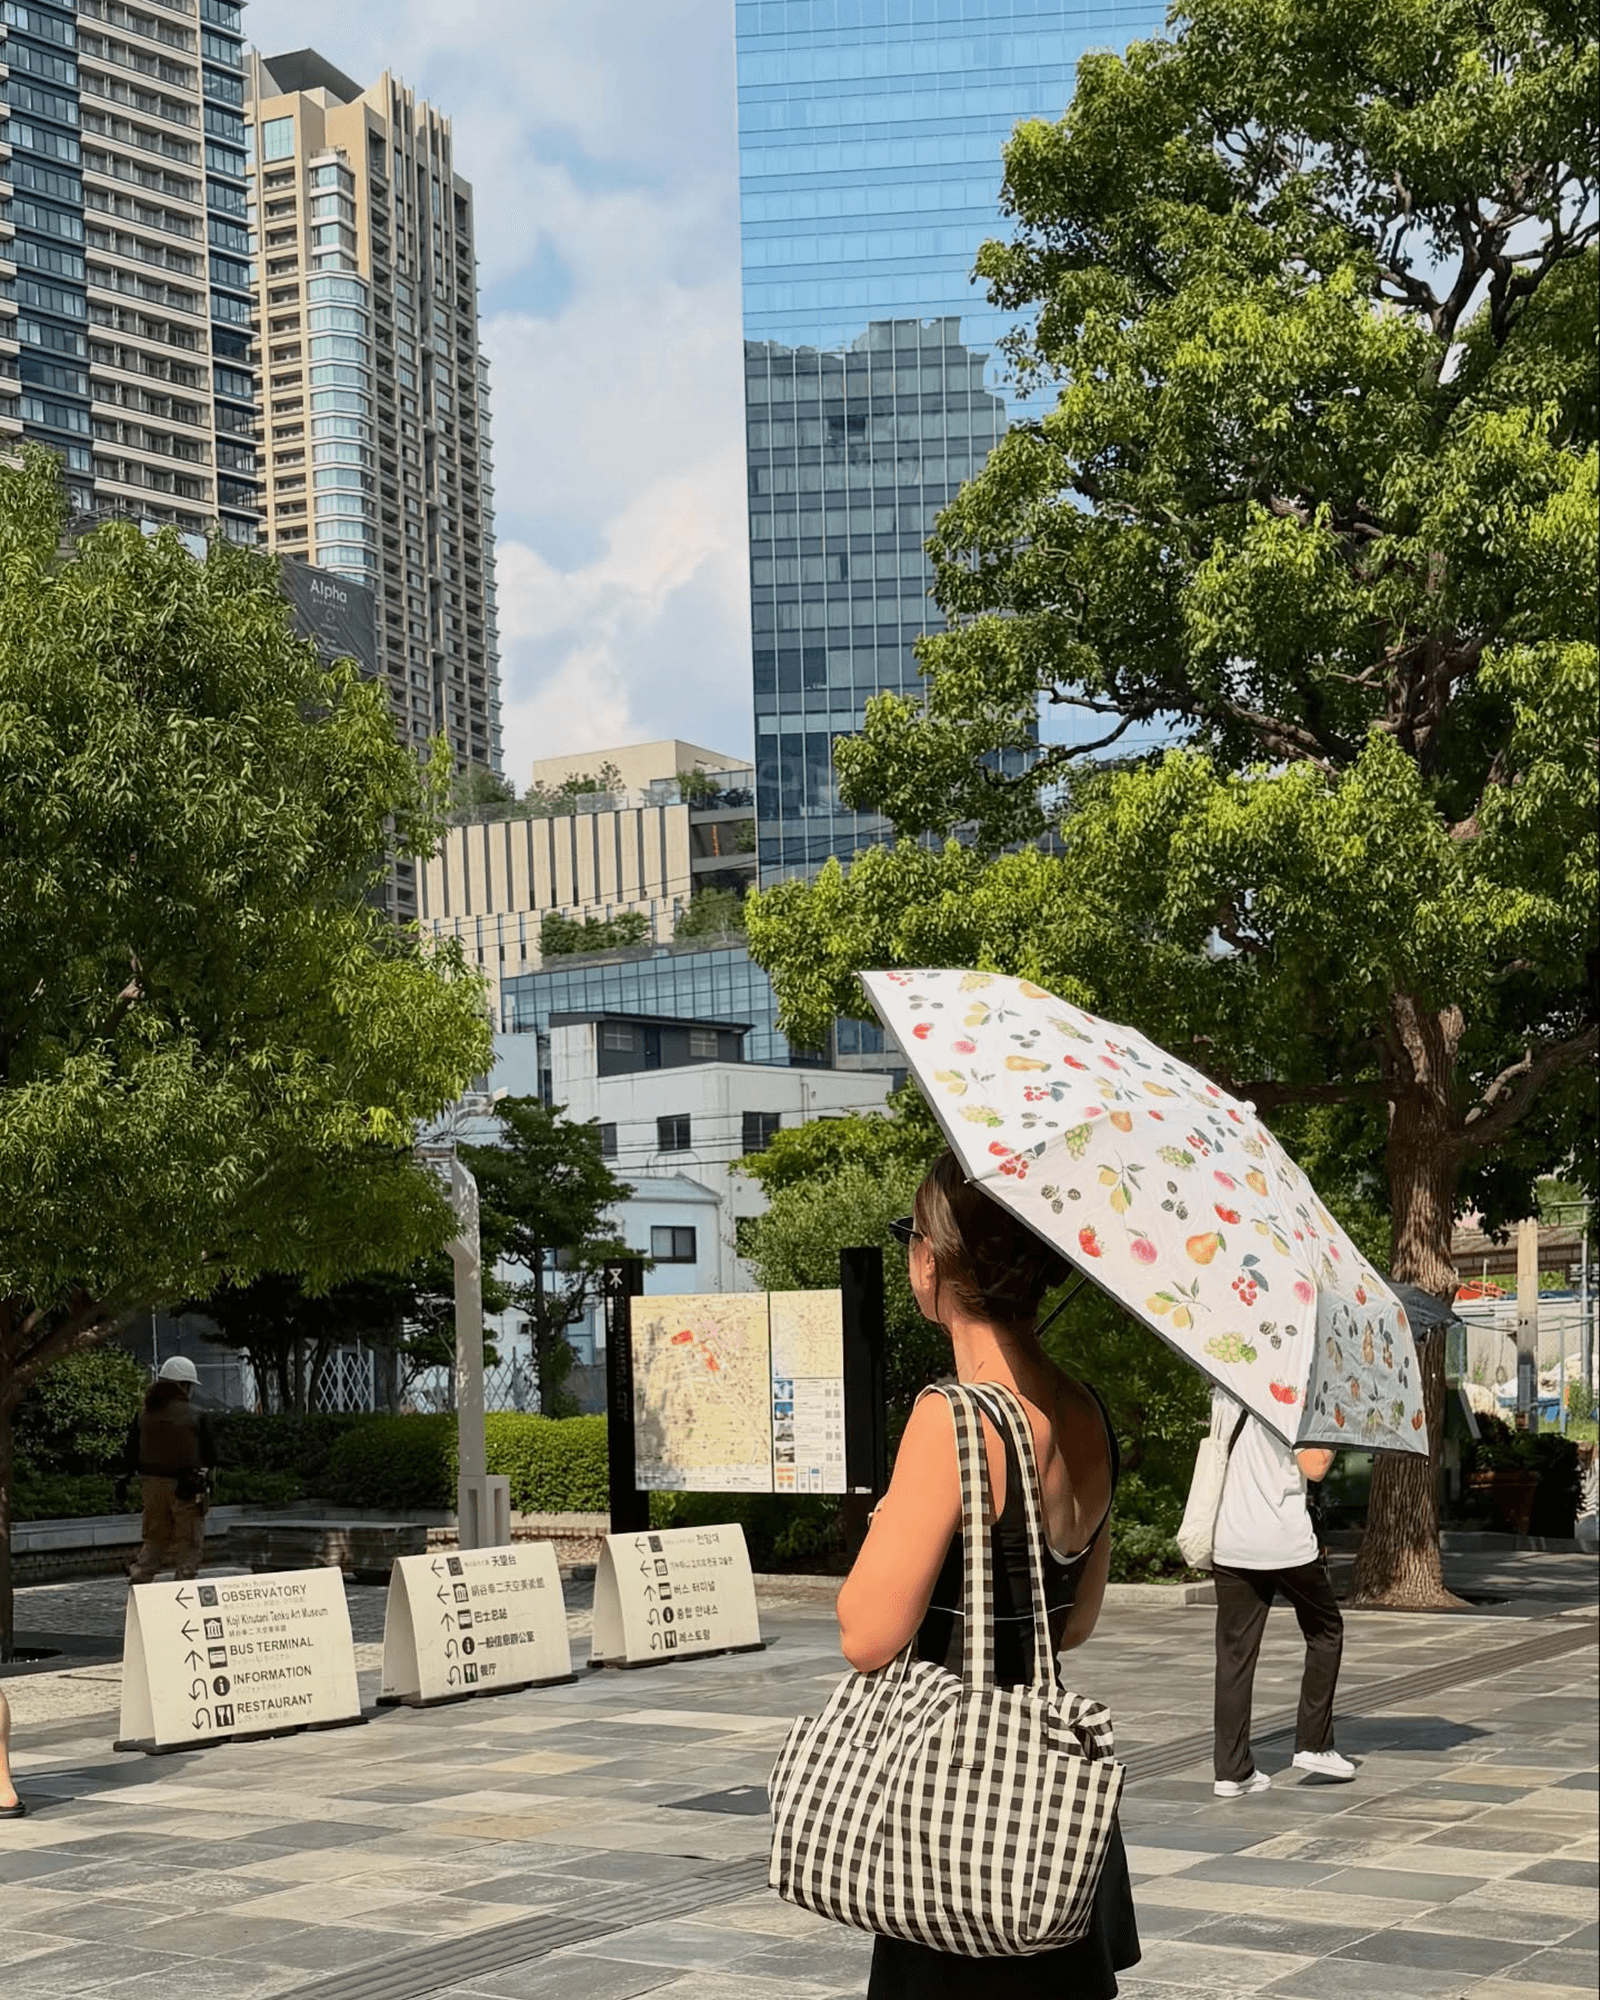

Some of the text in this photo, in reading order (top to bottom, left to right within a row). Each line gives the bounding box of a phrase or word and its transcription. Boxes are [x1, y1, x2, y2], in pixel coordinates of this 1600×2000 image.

[309, 578, 347, 604] Alpha
[221, 1584, 307, 1602] OBSERVATORY
[674, 1580, 716, 1596] 버스 터미널
[226, 1614, 240, 1627] Koji
[290, 1609, 301, 1620] Art
[301, 1607, 329, 1619] Museum
[230, 1636, 314, 1656] BUS TERMINAL
[233, 1665, 312, 1685] INFORMATION
[237, 1693, 313, 1714] RESTAURANT
